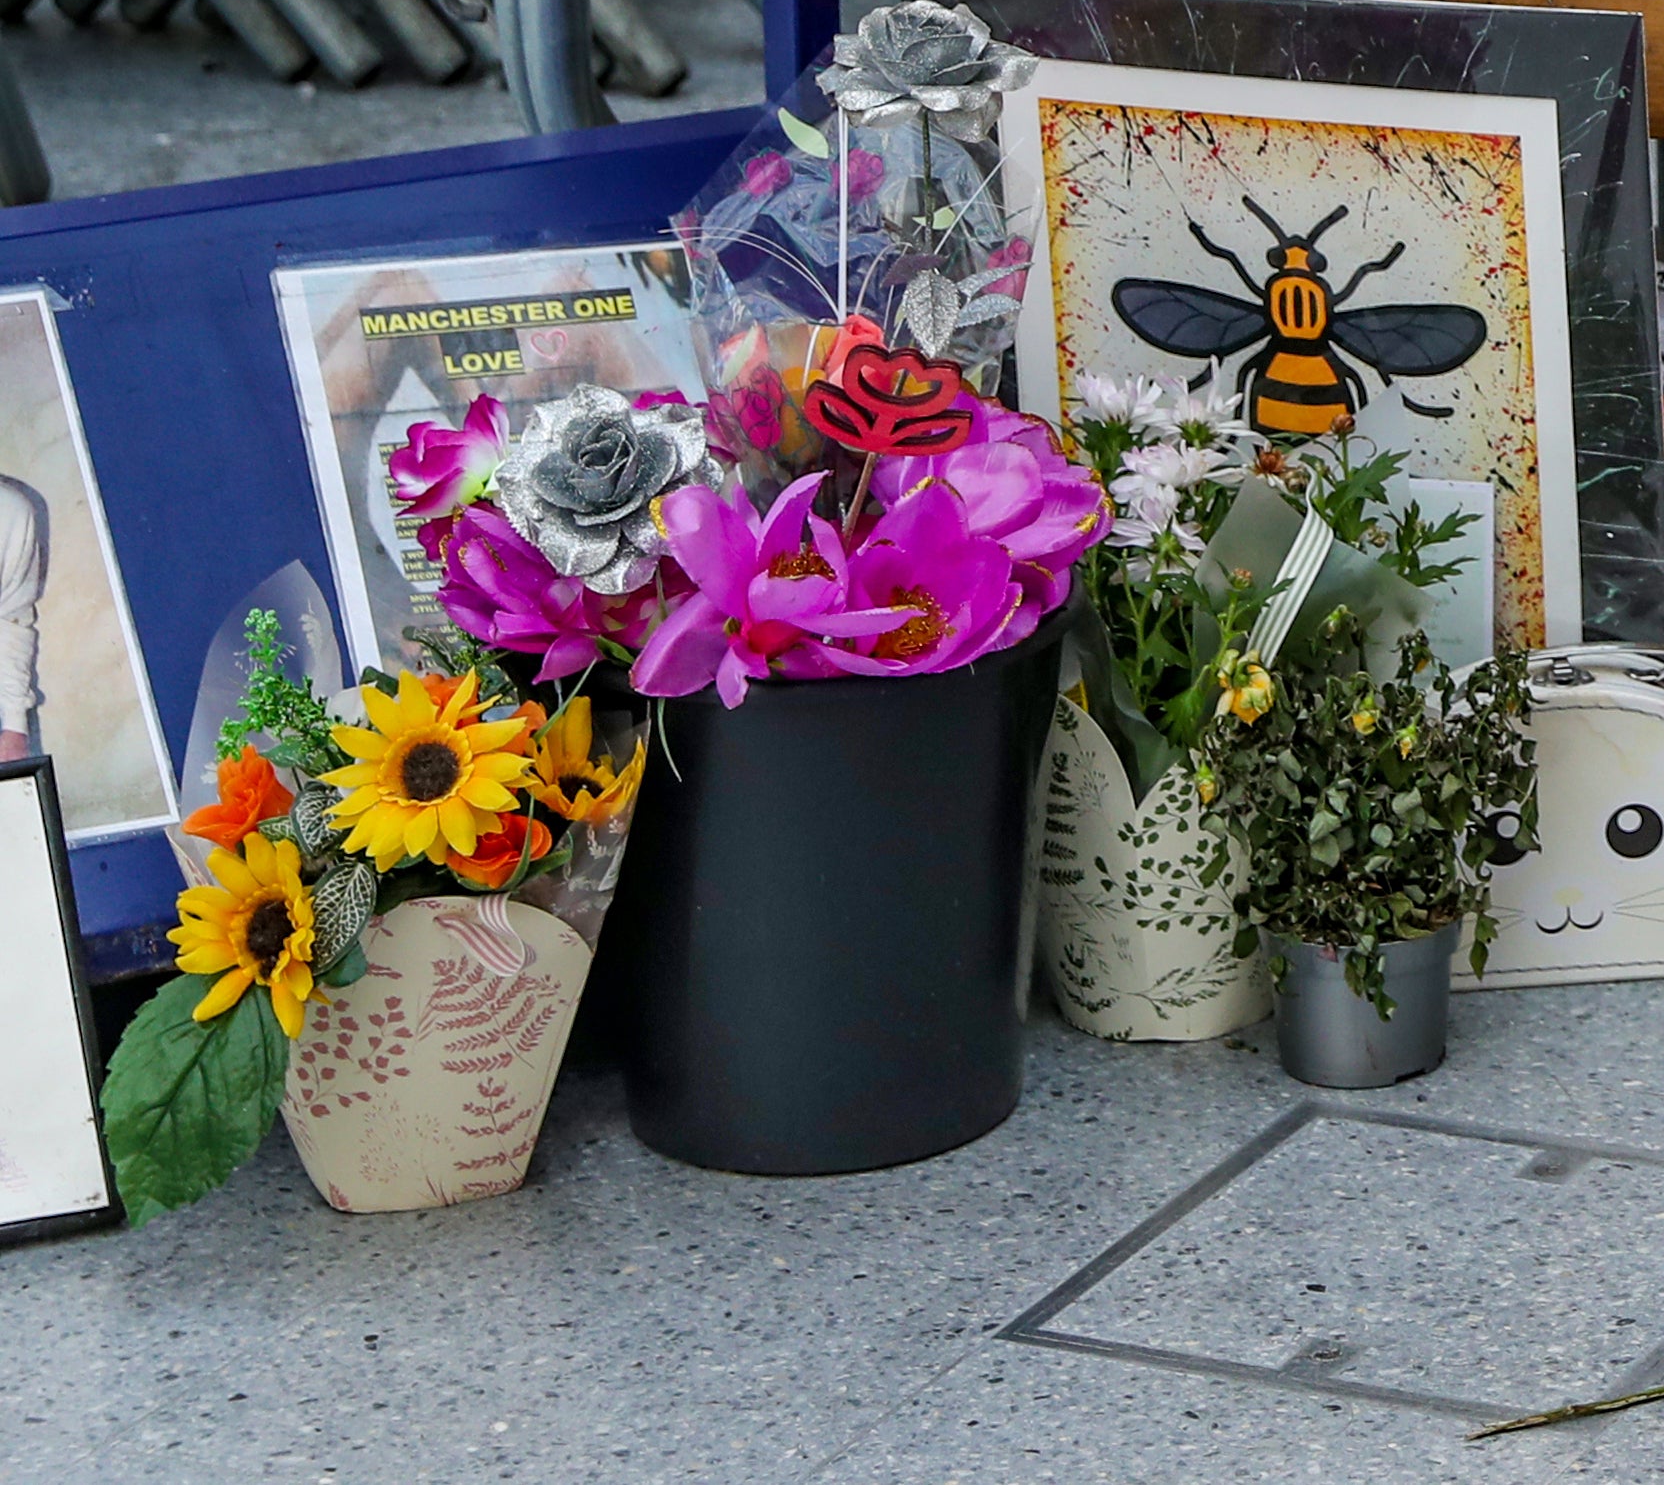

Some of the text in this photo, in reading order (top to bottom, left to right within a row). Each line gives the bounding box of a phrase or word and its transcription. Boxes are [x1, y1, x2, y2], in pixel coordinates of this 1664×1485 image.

[362, 293, 636, 337] MANCHESTER ONE
[443, 349, 524, 377] LOVE
